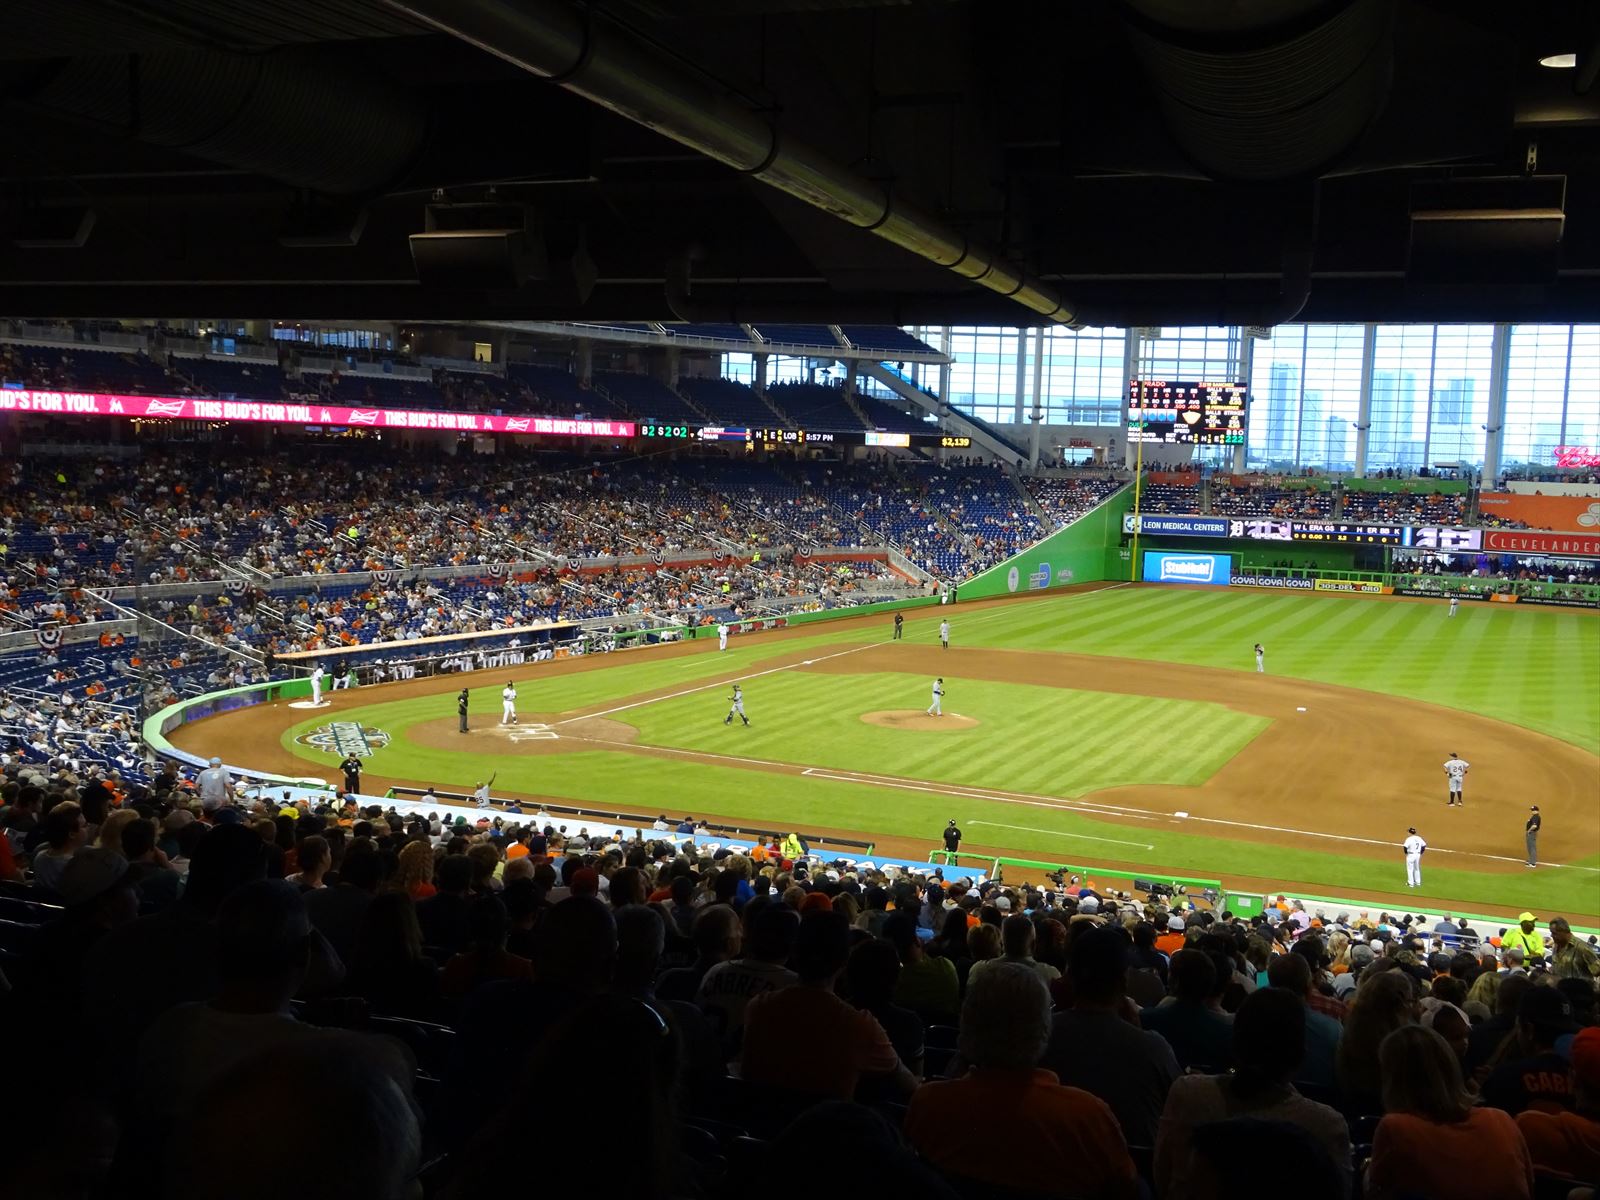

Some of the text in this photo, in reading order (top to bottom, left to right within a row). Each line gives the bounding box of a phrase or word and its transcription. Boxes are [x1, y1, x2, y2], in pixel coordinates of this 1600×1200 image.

[33, 392, 63, 411] FOR
[65, 394, 99, 413] YOU.
[193, 401, 312, 421] THIS BUD'S FOR YOU.
[384, 411, 408, 426] THIS
[408, 412, 438, 428] BUD'S
[438, 414, 456, 429] FOR
[457, 415, 478, 429] YOU.
[534, 419, 552, 432] THIS
[577, 421, 593, 434] FOR
[806, 433, 833, 441] 5:57 PM
[942, 437, 970, 447] $2,139
[1144, 520, 1224, 532] LEON MEDICAL CENTERS
[1231, 576, 1256, 585] GOYA
[1258, 577, 1283, 586] GOYA
[1286, 578, 1311, 588] GOYA
